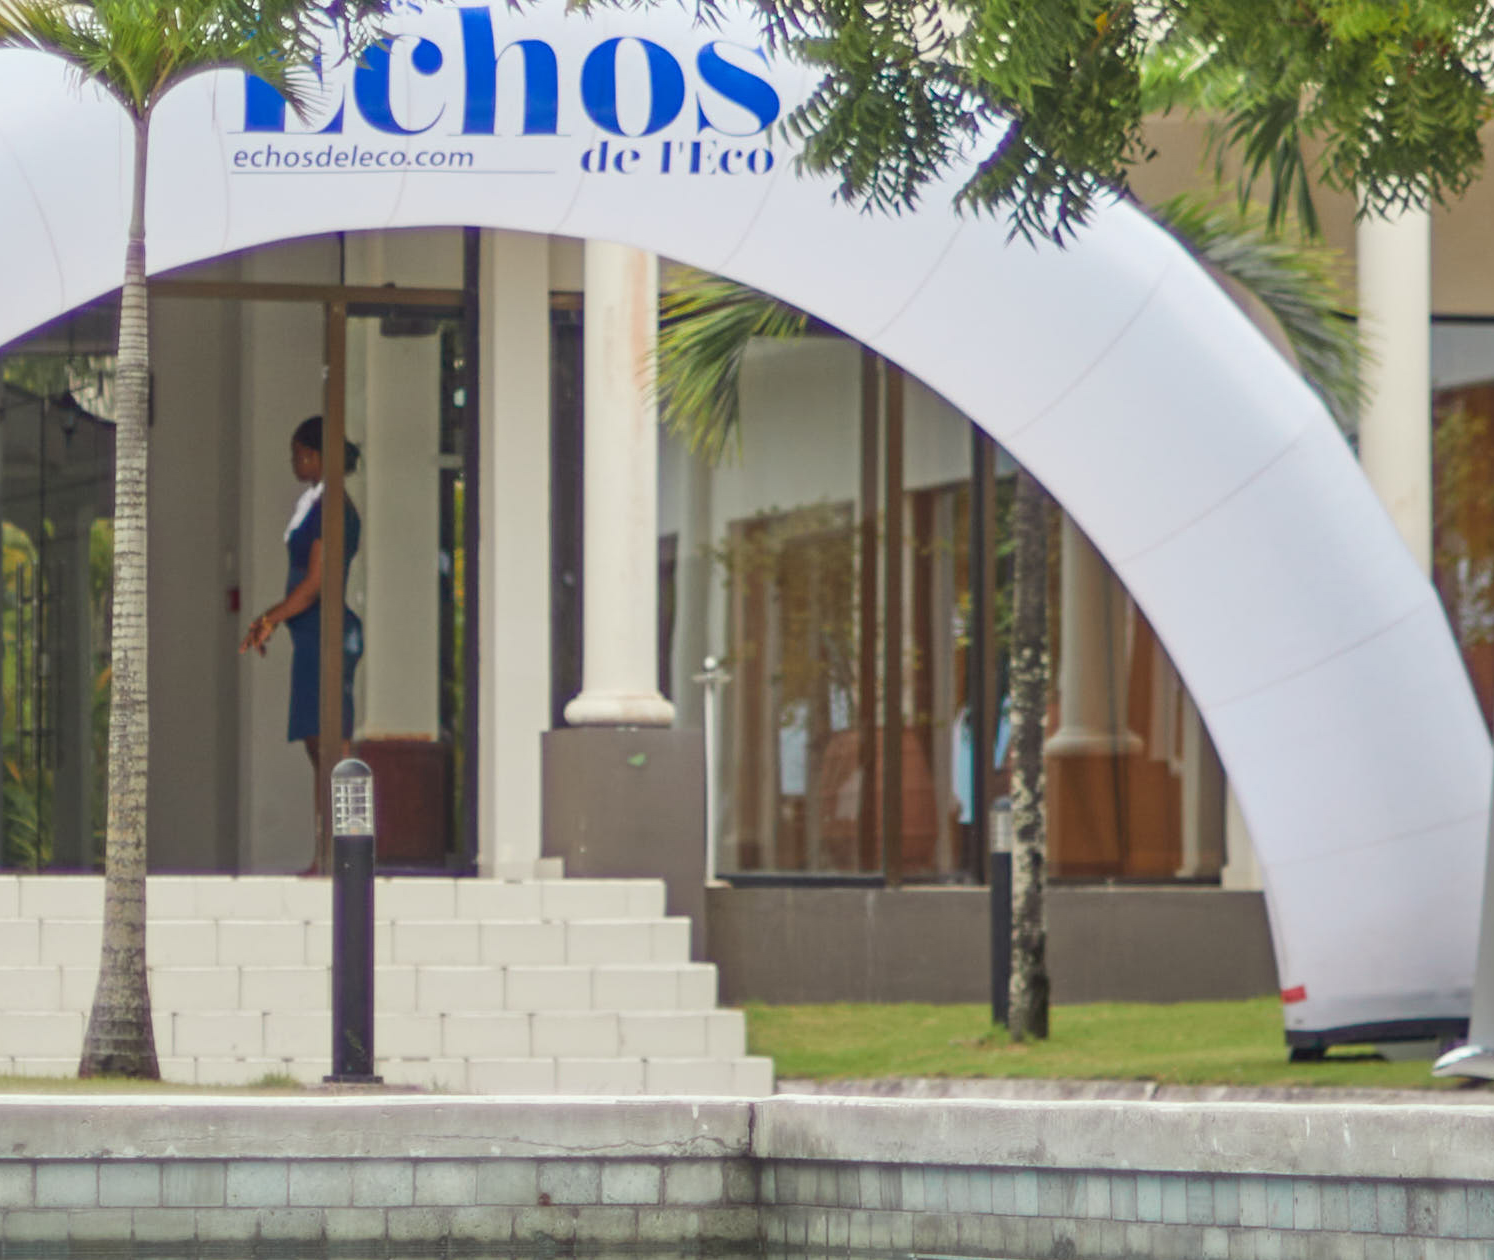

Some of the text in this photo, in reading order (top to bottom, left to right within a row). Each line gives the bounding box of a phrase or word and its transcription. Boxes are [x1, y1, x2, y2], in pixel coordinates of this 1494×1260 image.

[233, 144, 474, 168] echosdeleco.com
[580, 140, 774, 175] de l'Eco
